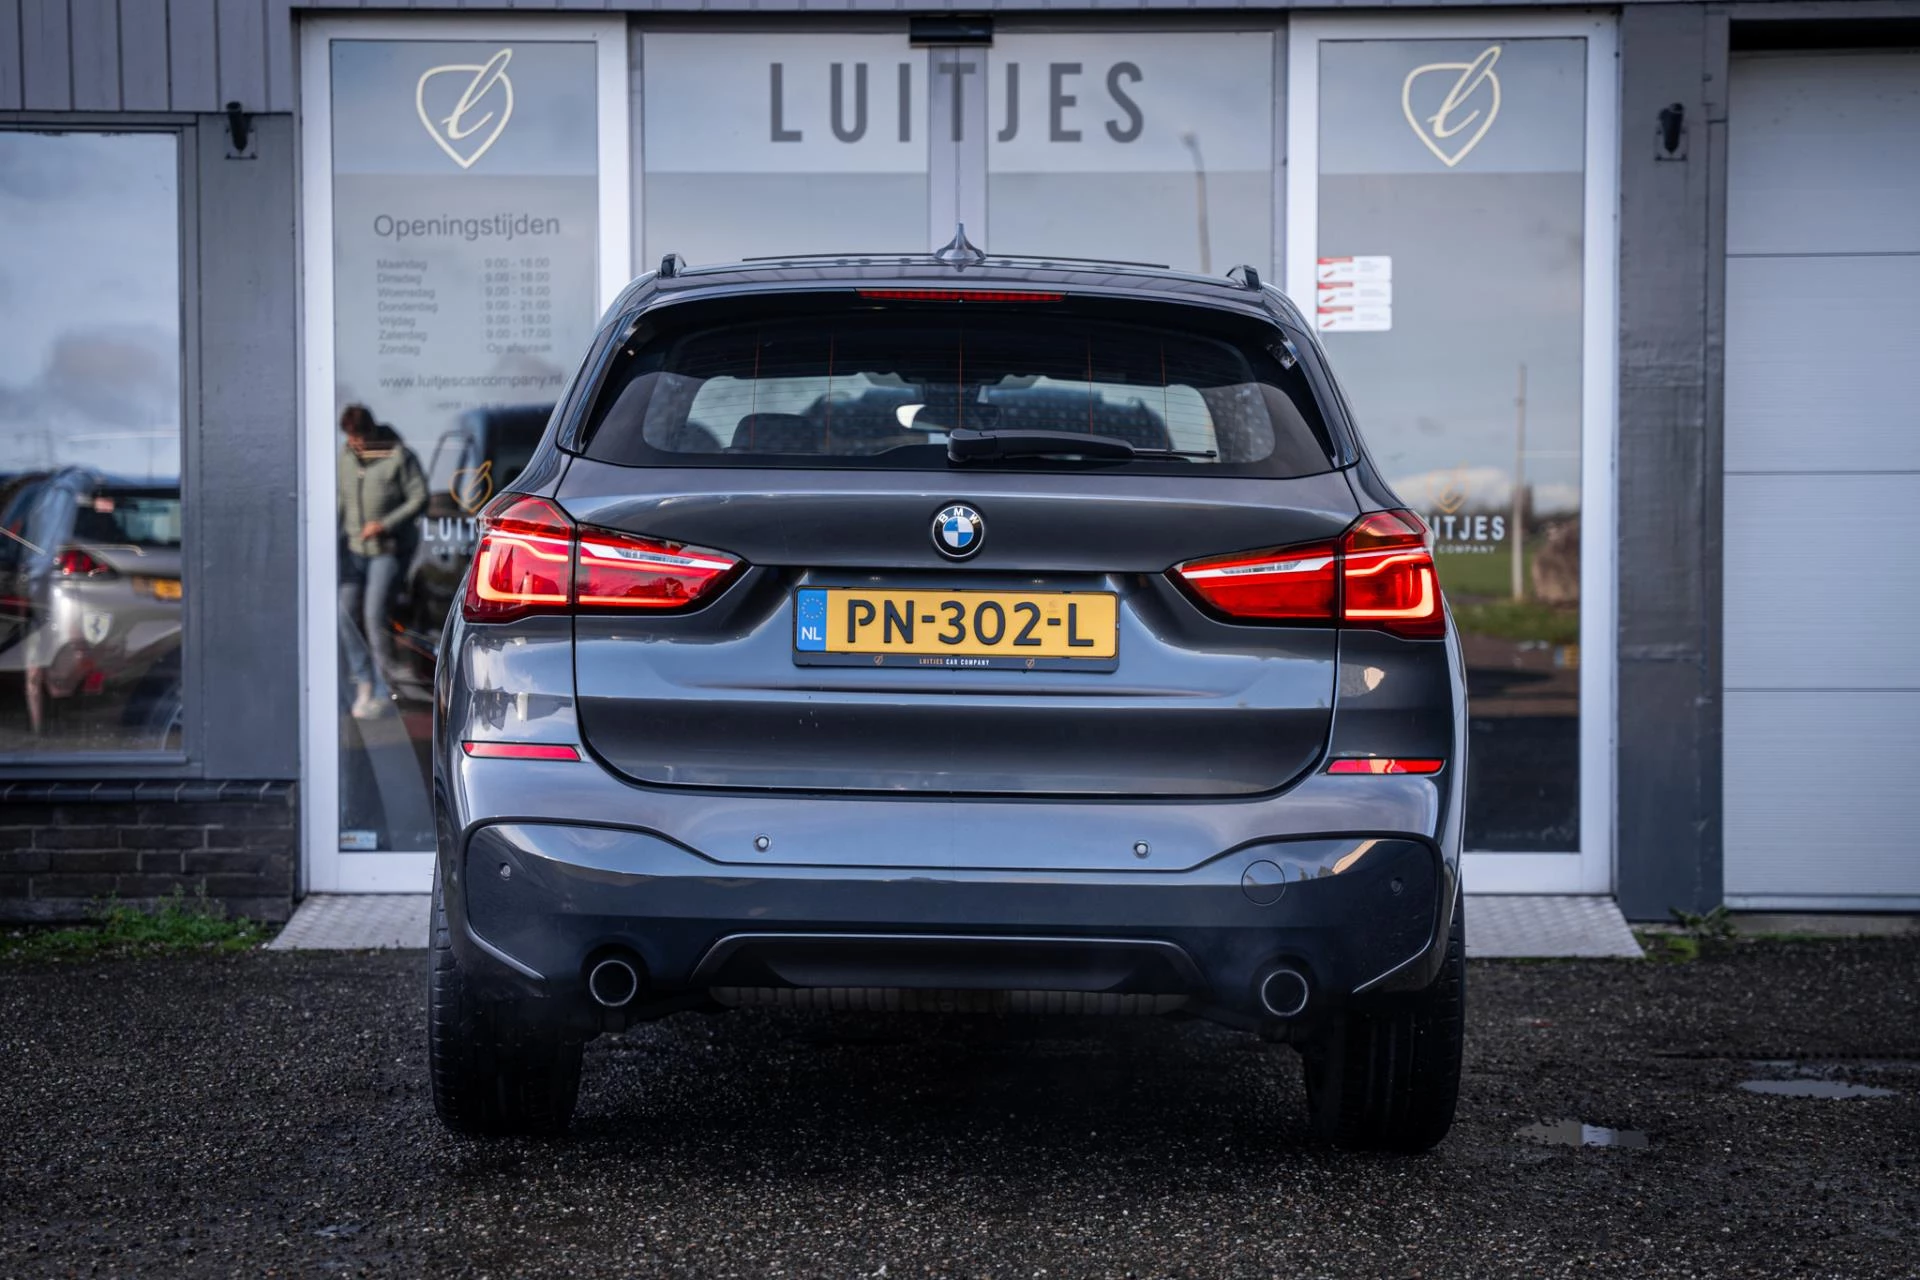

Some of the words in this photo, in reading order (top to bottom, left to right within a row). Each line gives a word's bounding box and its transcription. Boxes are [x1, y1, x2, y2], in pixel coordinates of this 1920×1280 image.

[770, 61, 1144, 143] LUITJES
[374, 214, 560, 241] Openingstijden
[376, 259, 428, 272] Maandag
[377, 273, 423, 286] Dinsdag
[377, 287, 436, 301] Woensdag
[377, 301, 439, 314] Donderdag
[378, 316, 416, 329] Vrijdag
[378, 343, 421, 356] Zondag
[379, 372, 563, 390] www.luitjescarcompany.nl
[938, 507, 980, 524] BMW
[422, 516, 476, 541] LUIT
[1424, 515, 1506, 541] ITJES
[847, 598, 1094, 647] PN-302-L
[801, 626, 822, 641] NL
[945, 658, 958, 666] CAR
[960, 658, 990, 666] COMPANY
